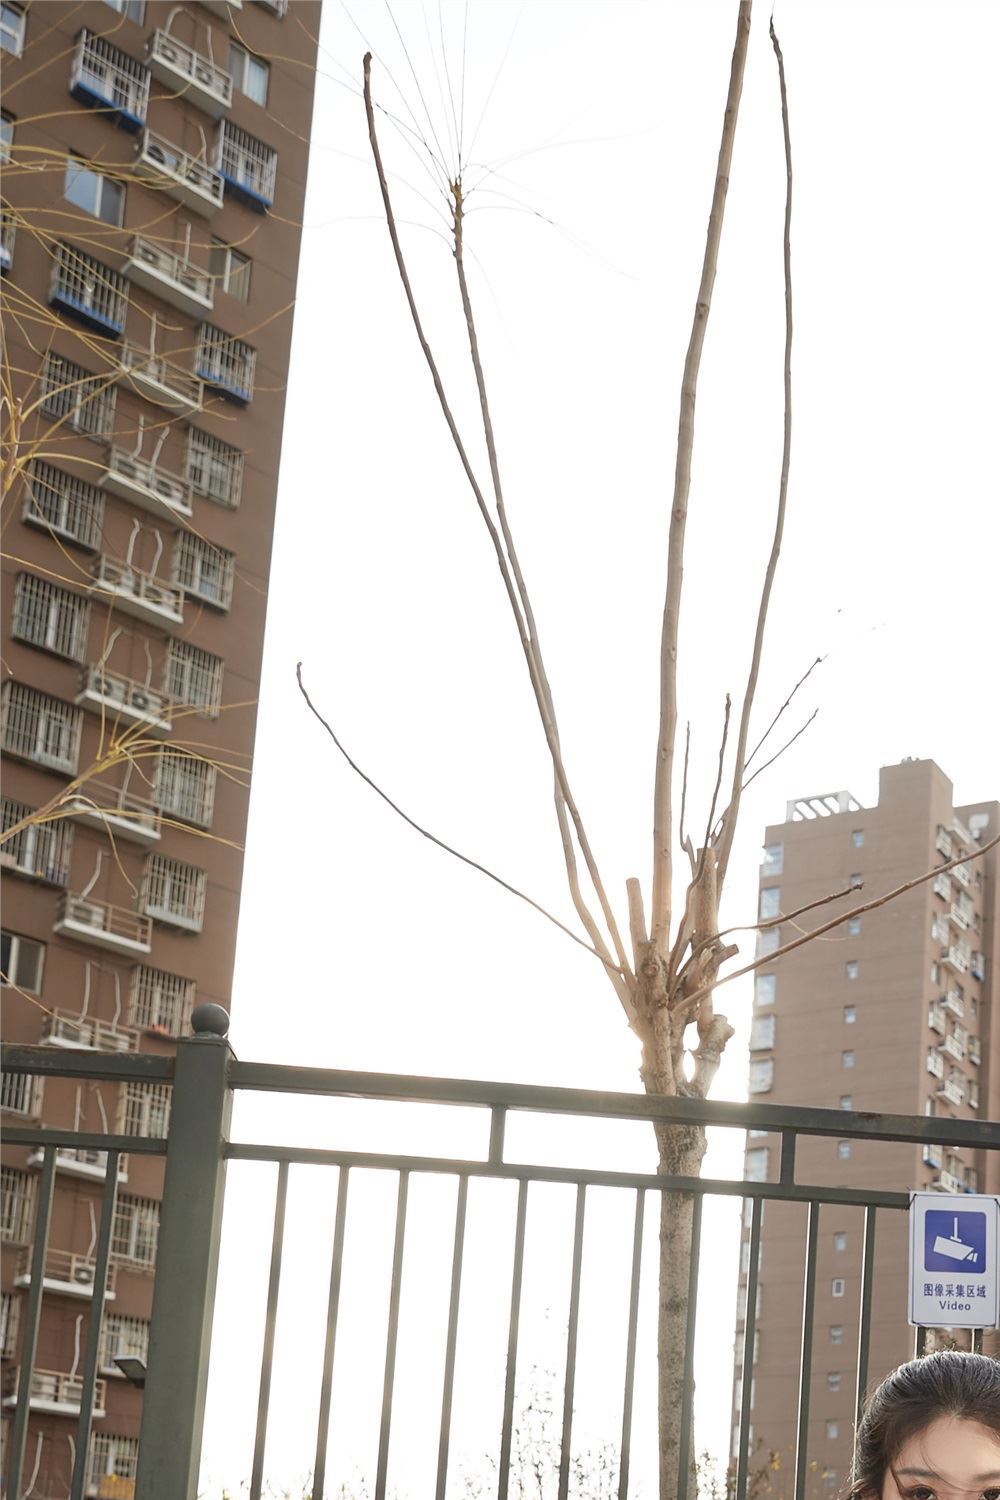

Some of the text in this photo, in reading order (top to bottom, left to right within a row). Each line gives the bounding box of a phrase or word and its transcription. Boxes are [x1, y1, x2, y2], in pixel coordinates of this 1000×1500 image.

[923, 1283, 987, 1298] 图像采集区域
[939, 1301, 971, 1311] Video
